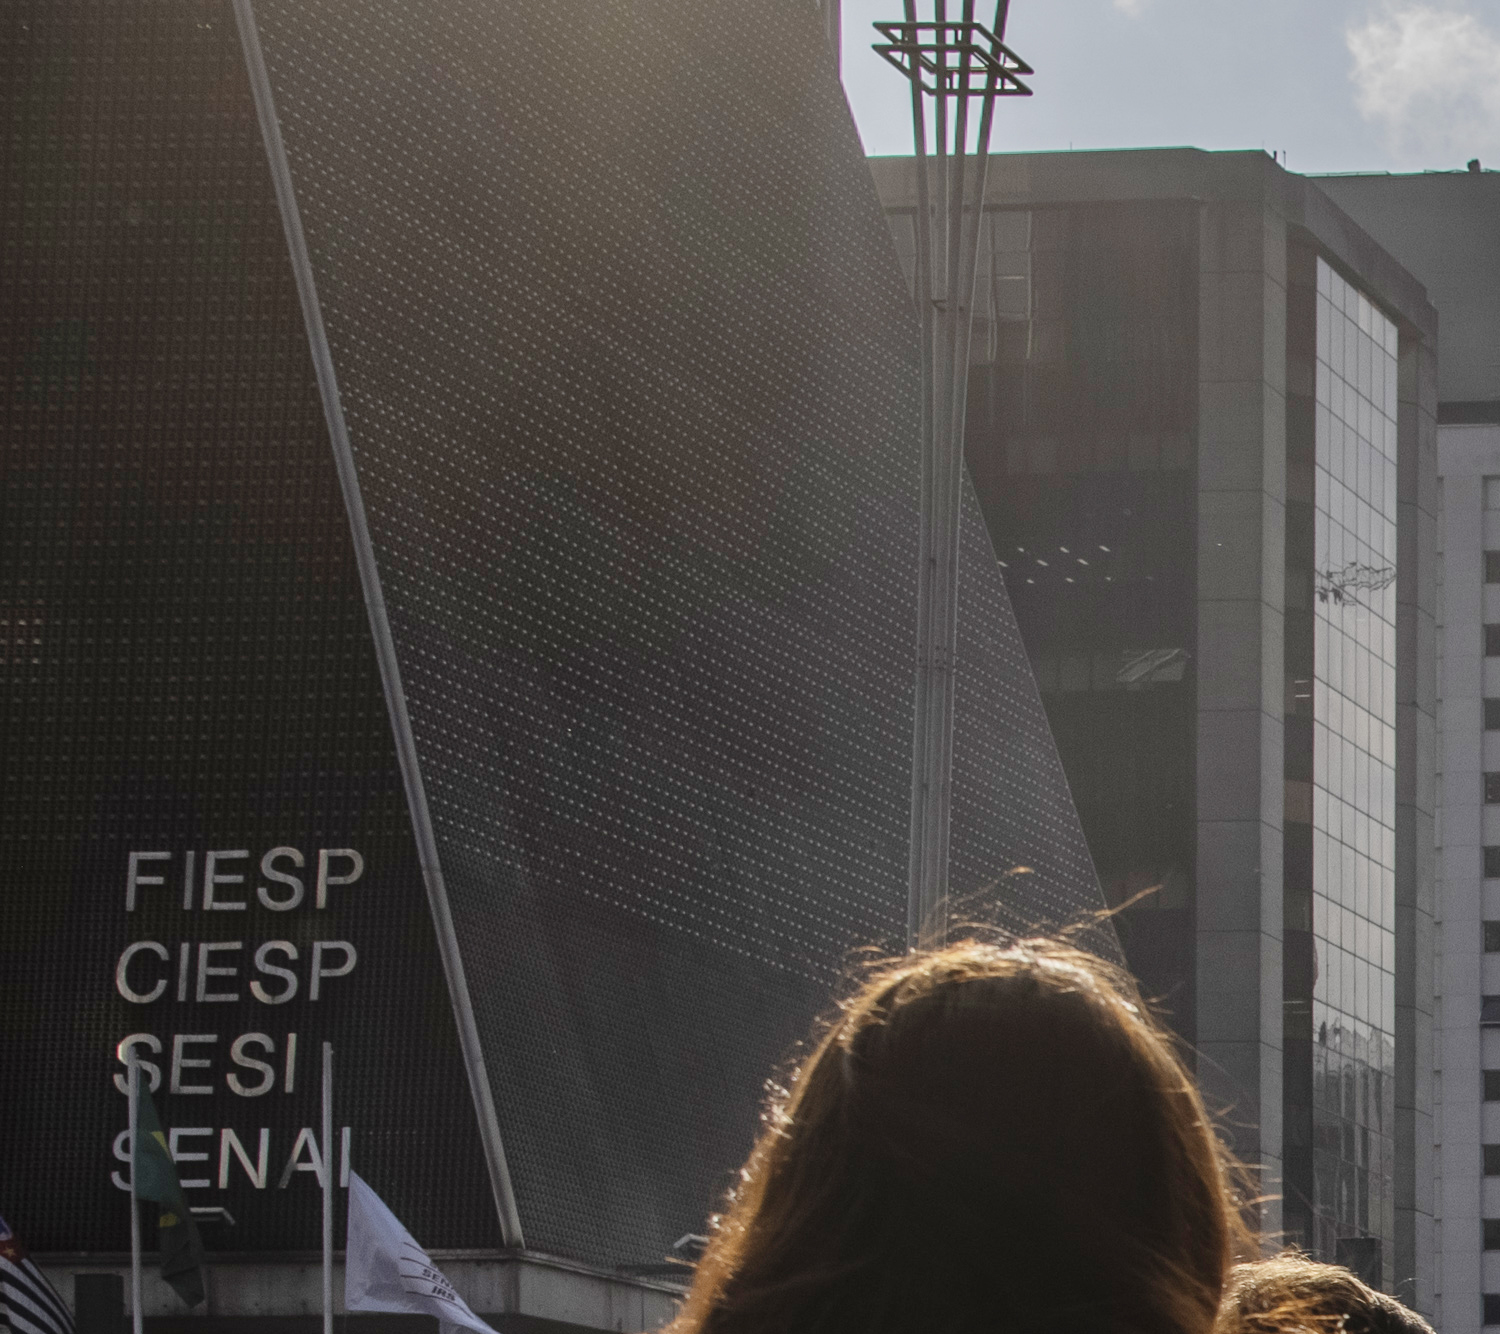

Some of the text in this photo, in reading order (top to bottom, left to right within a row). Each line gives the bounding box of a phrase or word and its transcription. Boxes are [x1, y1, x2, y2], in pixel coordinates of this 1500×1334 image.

[125, 846, 364, 911] FIESP
[115, 940, 358, 1004] CIESP
[112, 1032, 298, 1097] SESI
